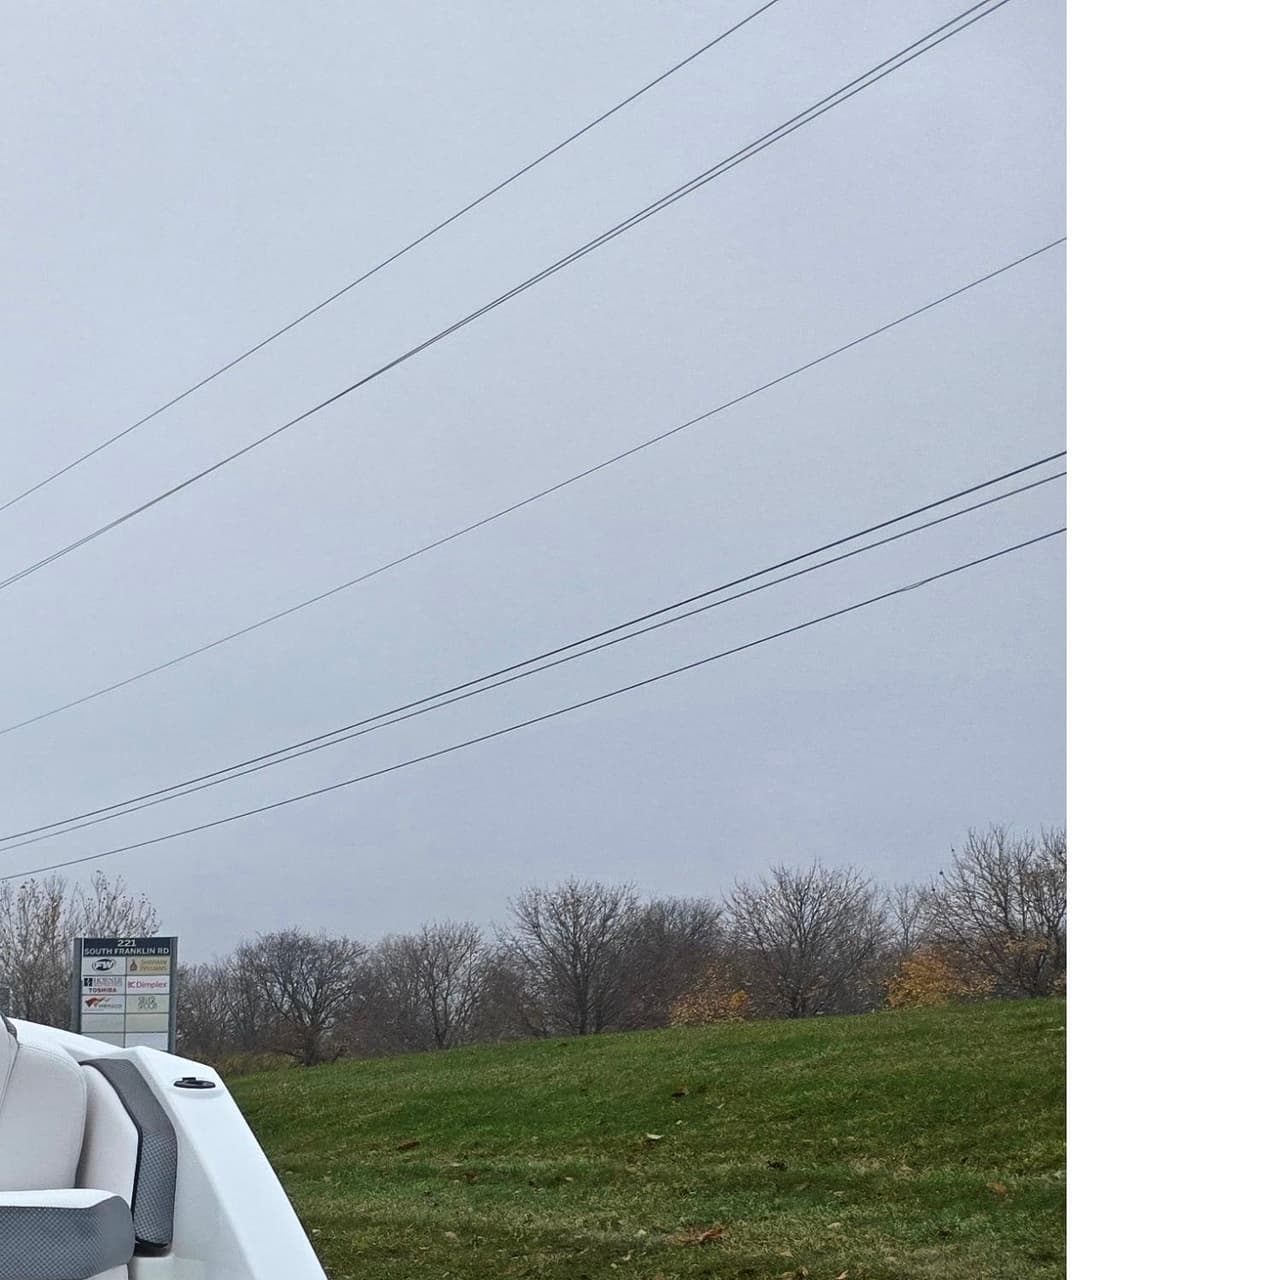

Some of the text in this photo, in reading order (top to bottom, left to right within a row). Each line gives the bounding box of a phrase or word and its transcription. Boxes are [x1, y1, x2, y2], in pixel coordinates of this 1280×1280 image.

[117, 939, 137, 947] 221
[84, 947, 113, 955] SOUTH
[114, 947, 156, 955] FRANKLIN
[137, 981, 168, 989] Dimplex
